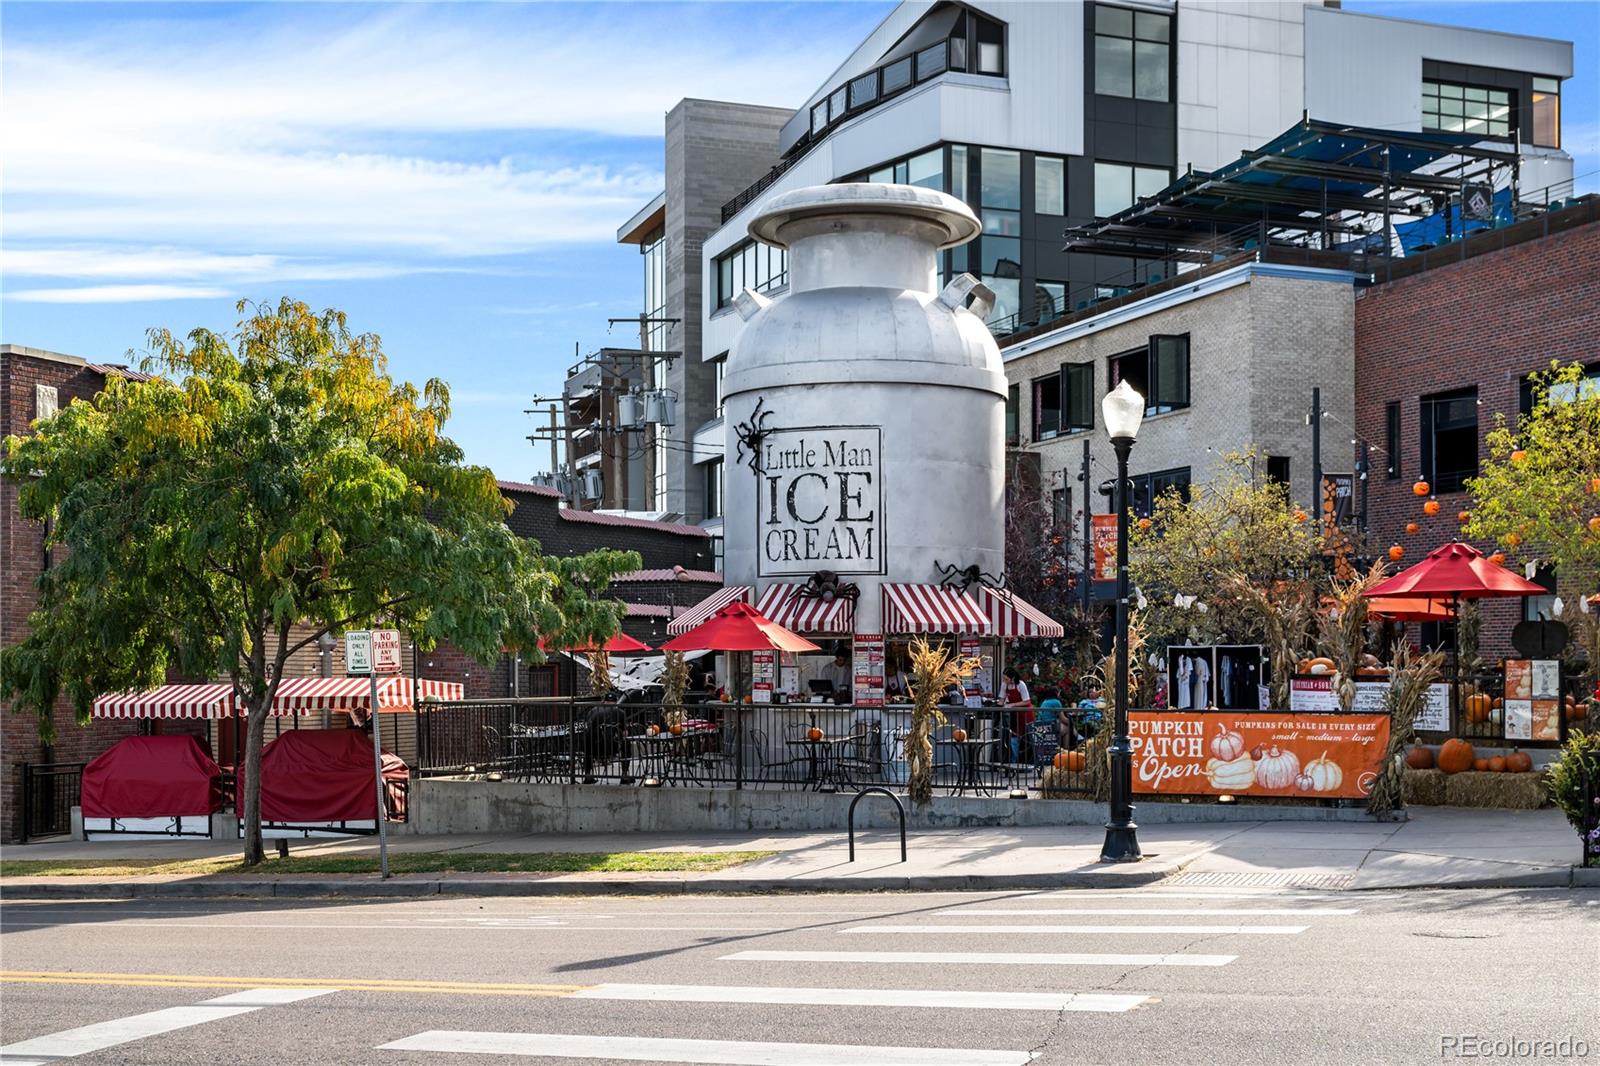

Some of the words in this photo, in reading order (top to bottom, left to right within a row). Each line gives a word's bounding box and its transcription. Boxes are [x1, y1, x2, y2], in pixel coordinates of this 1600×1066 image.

[766, 439, 816, 470] Little
[823, 440, 873, 467] Man
[766, 471, 873, 525] ICE
[766, 527, 874, 561] CREAM
[374, 641, 398, 649] PARKING
[1128, 720, 1204, 735] PUMPKIN
[1234, 721, 1276, 729] PUMPKINS
[1357, 723, 1376, 731] SIZE
[1128, 737, 1204, 757] PATCH
[1272, 732, 1299, 740] small
[1306, 733, 1342, 741] medium
[1351, 733, 1376, 745] large
[1140, 756, 1203, 789] Open
